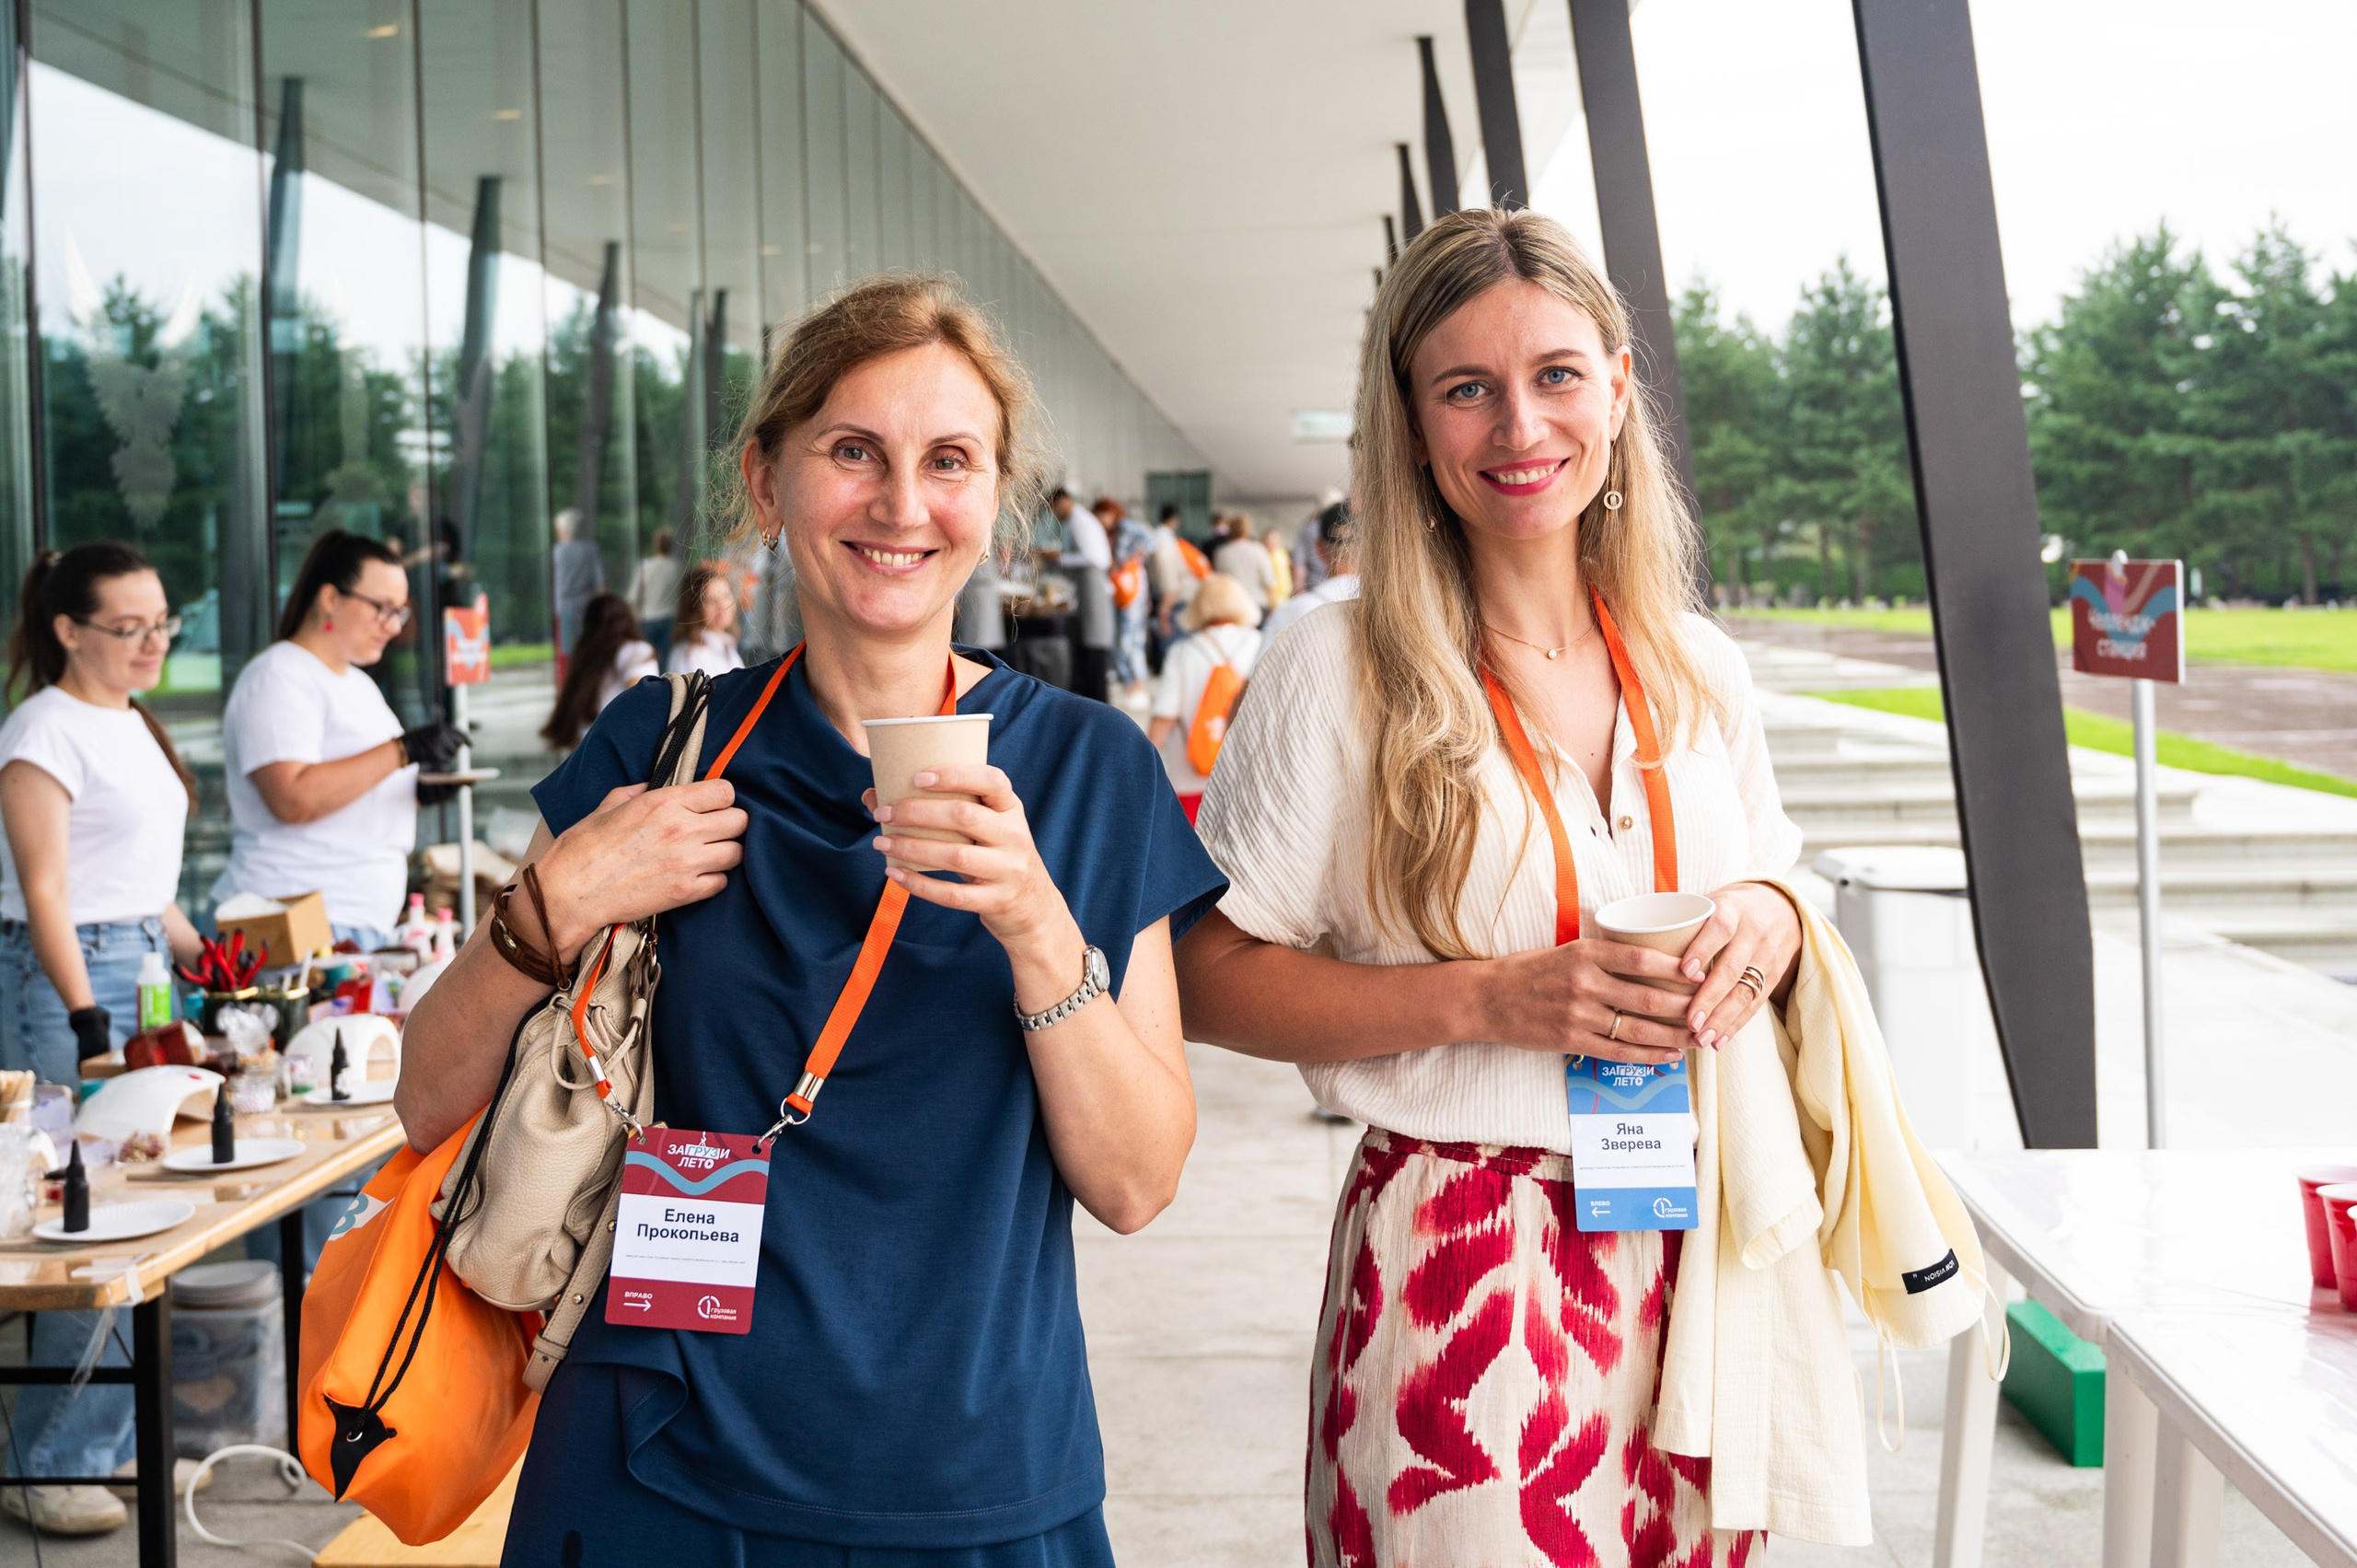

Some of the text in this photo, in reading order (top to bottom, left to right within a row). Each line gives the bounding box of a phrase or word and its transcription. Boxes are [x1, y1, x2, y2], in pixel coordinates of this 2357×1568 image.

[1602, 1066, 1655, 1077] ЗАГРУЗИ
[1613, 1076, 1643, 1086] ЛЕТО
[1617, 1122, 1643, 1135] Яна
[668, 1144, 730, 1160] ЗАГРУЗИ
[1601, 1138, 1662, 1153] Зверева
[678, 1156, 714, 1169] ЛЕТО
[664, 1208, 715, 1225] Елена
[637, 1224, 739, 1243] Прокопьева
[1924, 1268, 1946, 1283] VISION
[624, 1291, 653, 1299] ВПРАВО
